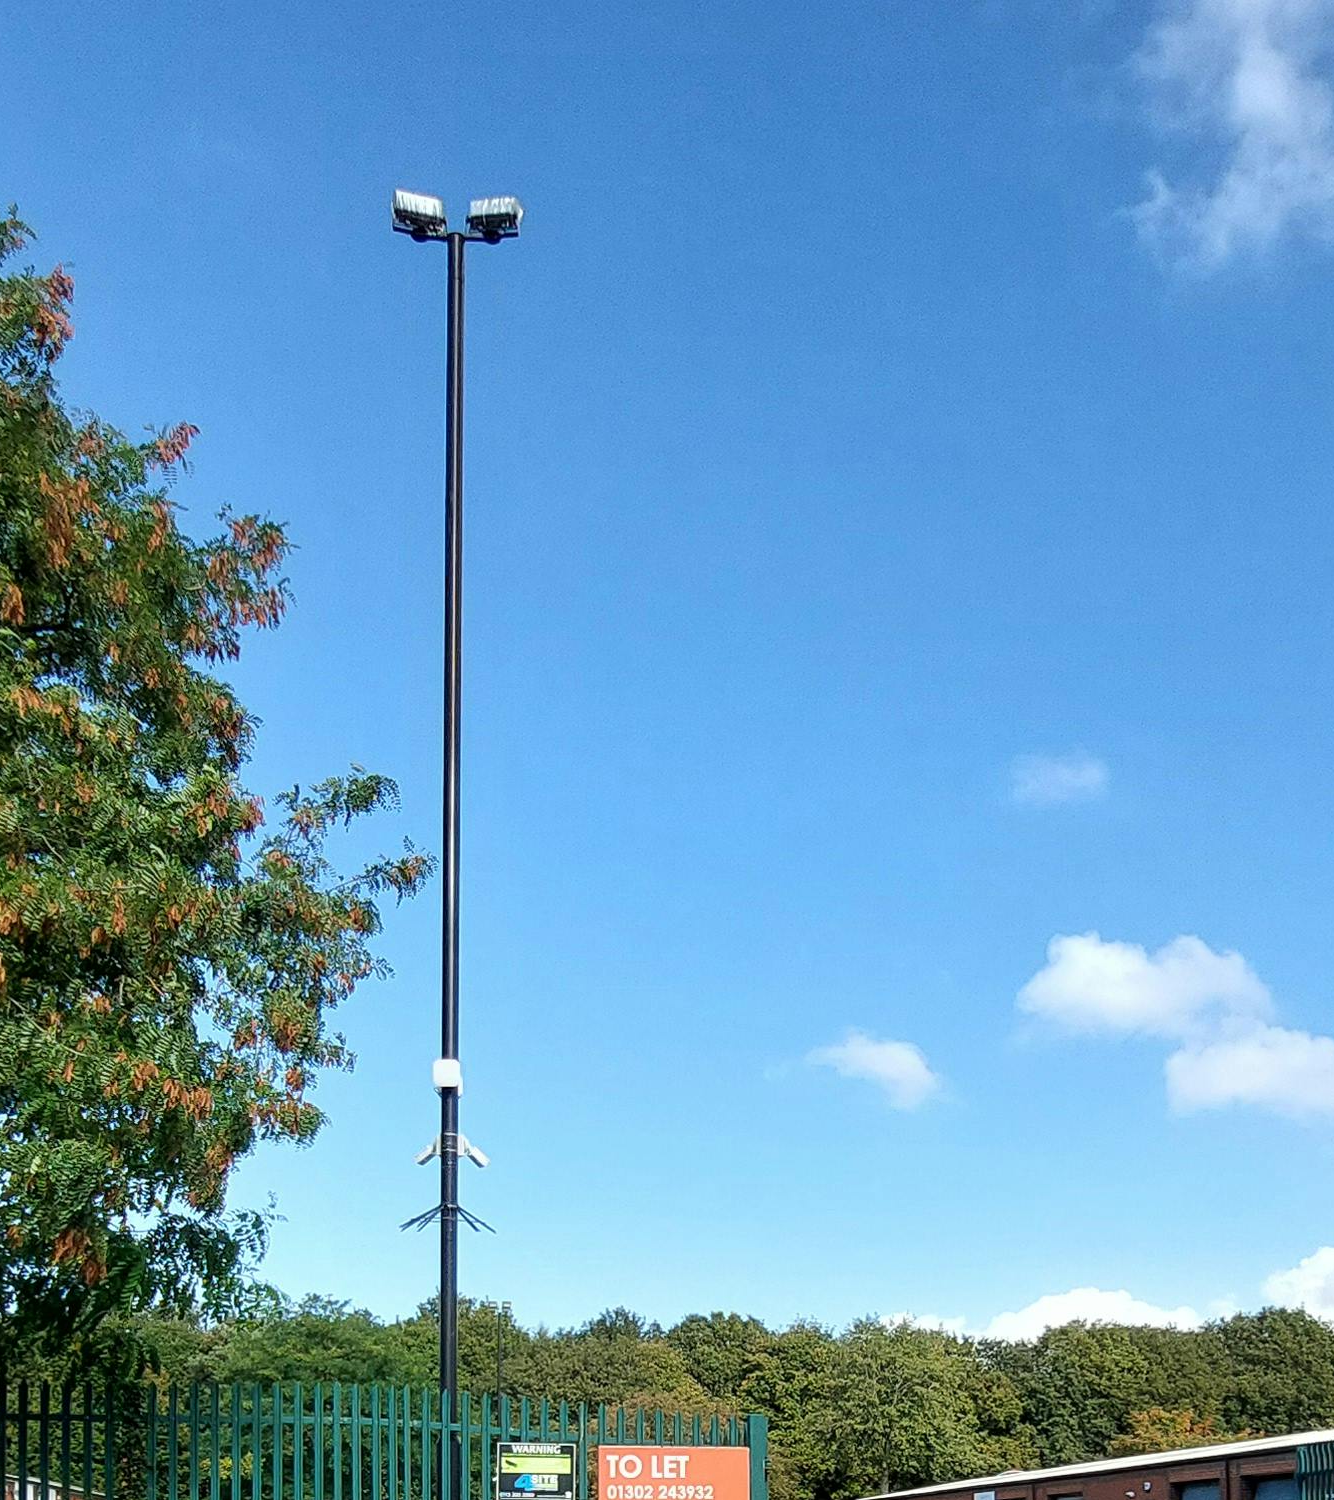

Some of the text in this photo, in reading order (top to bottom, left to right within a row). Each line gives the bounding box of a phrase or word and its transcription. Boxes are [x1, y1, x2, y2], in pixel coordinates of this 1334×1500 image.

[512, 1445, 561, 1454] WARNING
[606, 1454, 689, 1479] TO LET
[607, 1485, 714, 1500] 01302 243932
